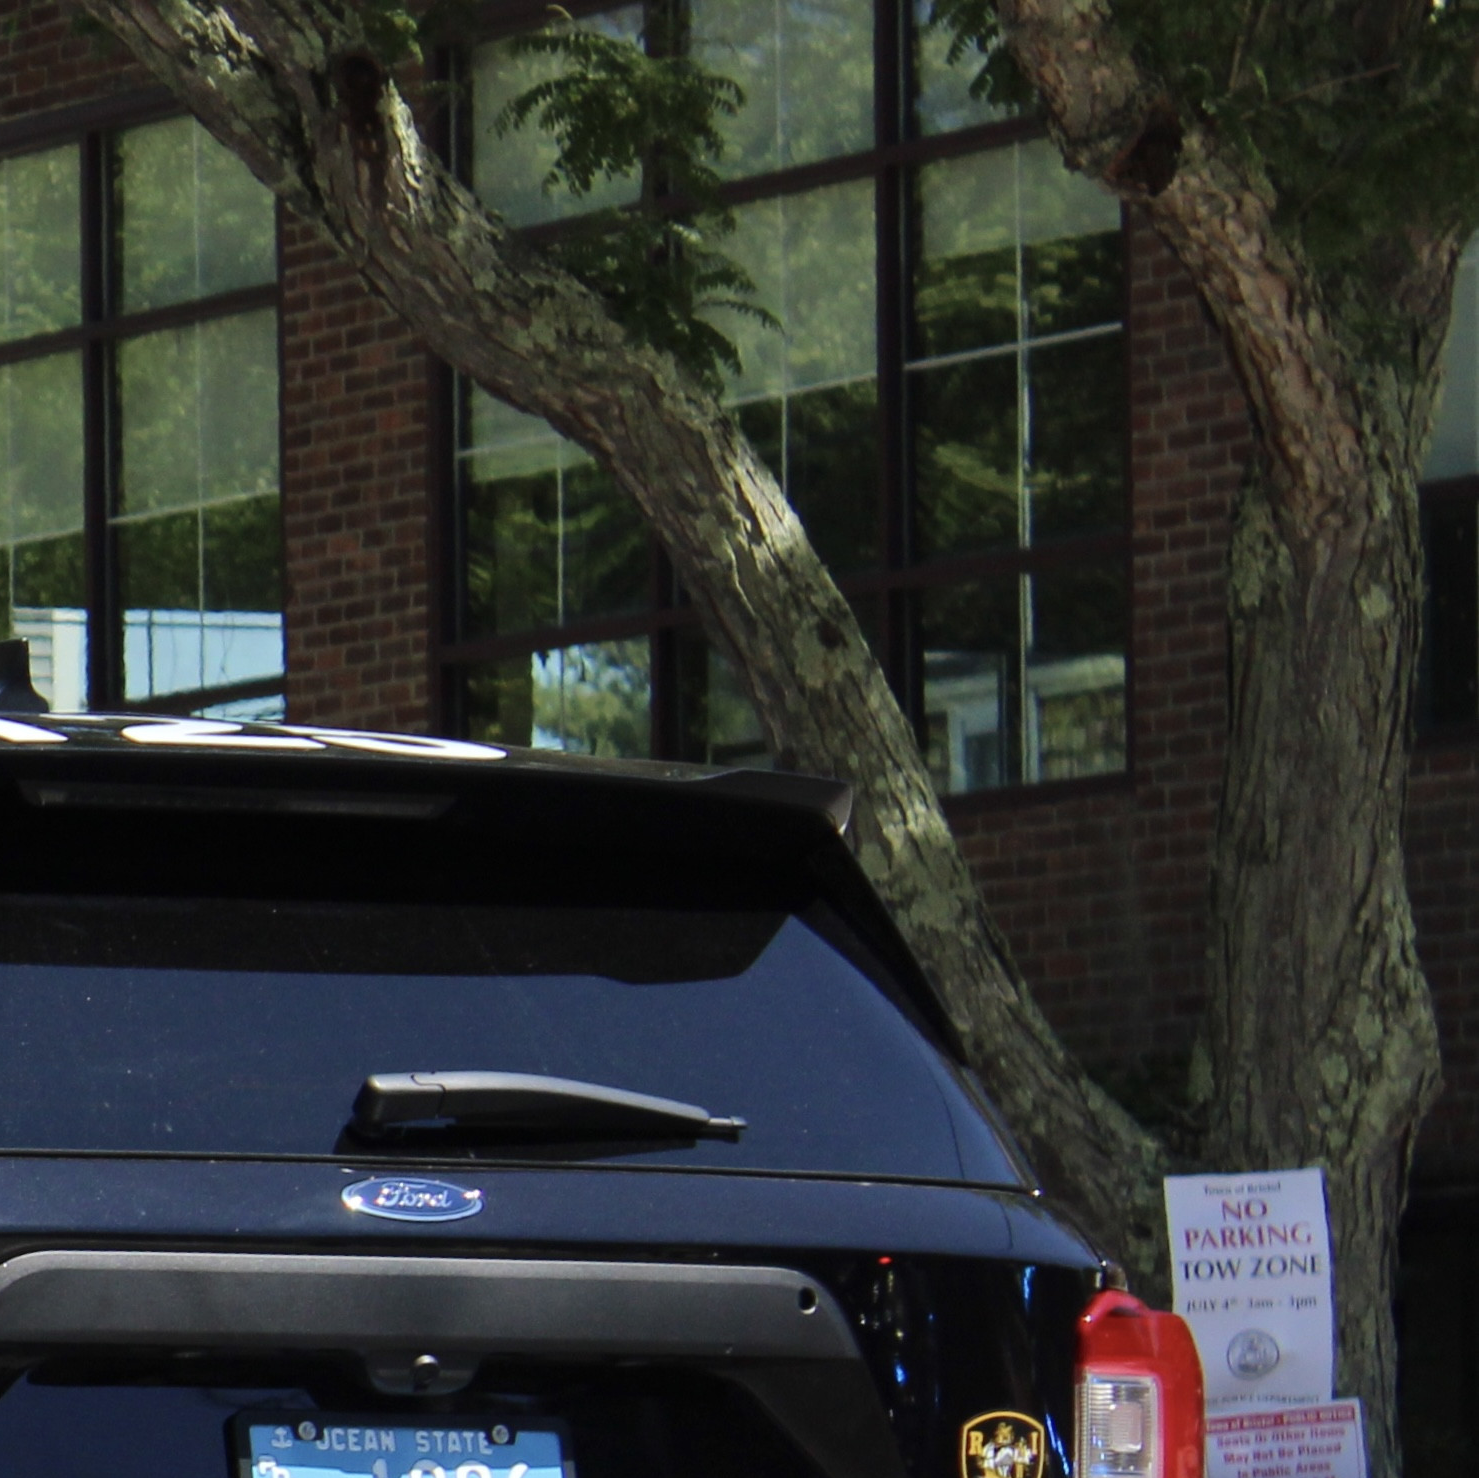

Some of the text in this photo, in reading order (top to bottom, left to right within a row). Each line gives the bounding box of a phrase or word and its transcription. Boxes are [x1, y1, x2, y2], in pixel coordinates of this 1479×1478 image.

[377, 1182, 453, 1208] Ford
[1247, 1180, 1281, 1194] Bristol
[1221, 1199, 1268, 1222] NO
[1184, 1221, 1312, 1250] PARKING
[1180, 1254, 1321, 1281] TOW ZONE
[1187, 1299, 1217, 1314] JULY
[316, 1427, 493, 1455] OCEAN STATE
[968, 1430, 1039, 1456] R I
[1298, 1443, 1342, 1456] Placed
[1253, 1465, 1291, 1478] Public
[1296, 1461, 1331, 1474] Areas
